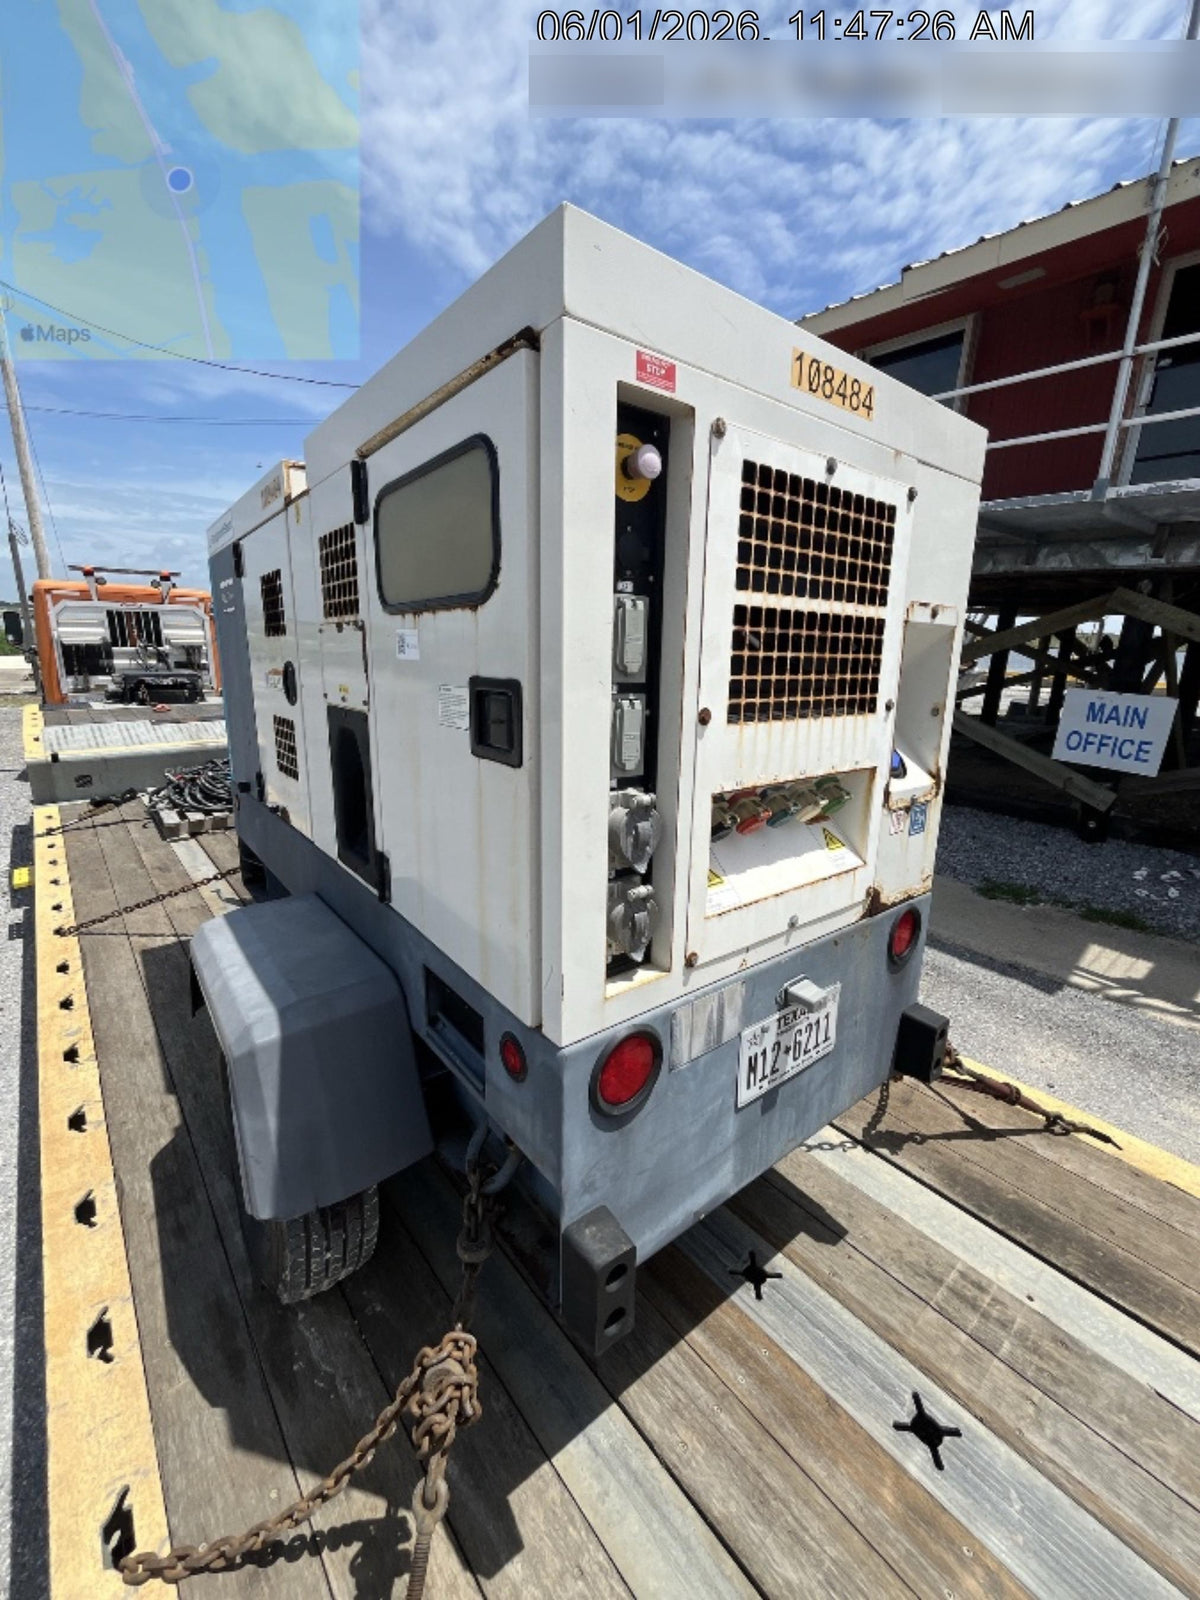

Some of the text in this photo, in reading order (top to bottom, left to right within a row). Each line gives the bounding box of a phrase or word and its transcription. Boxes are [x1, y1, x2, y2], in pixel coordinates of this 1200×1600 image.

[795, 351, 873, 417] 108484
[1085, 701, 1150, 730] MAIN
[1065, 730, 1153, 763] OFFICE
[776, 1007, 808, 1030] TEXA
